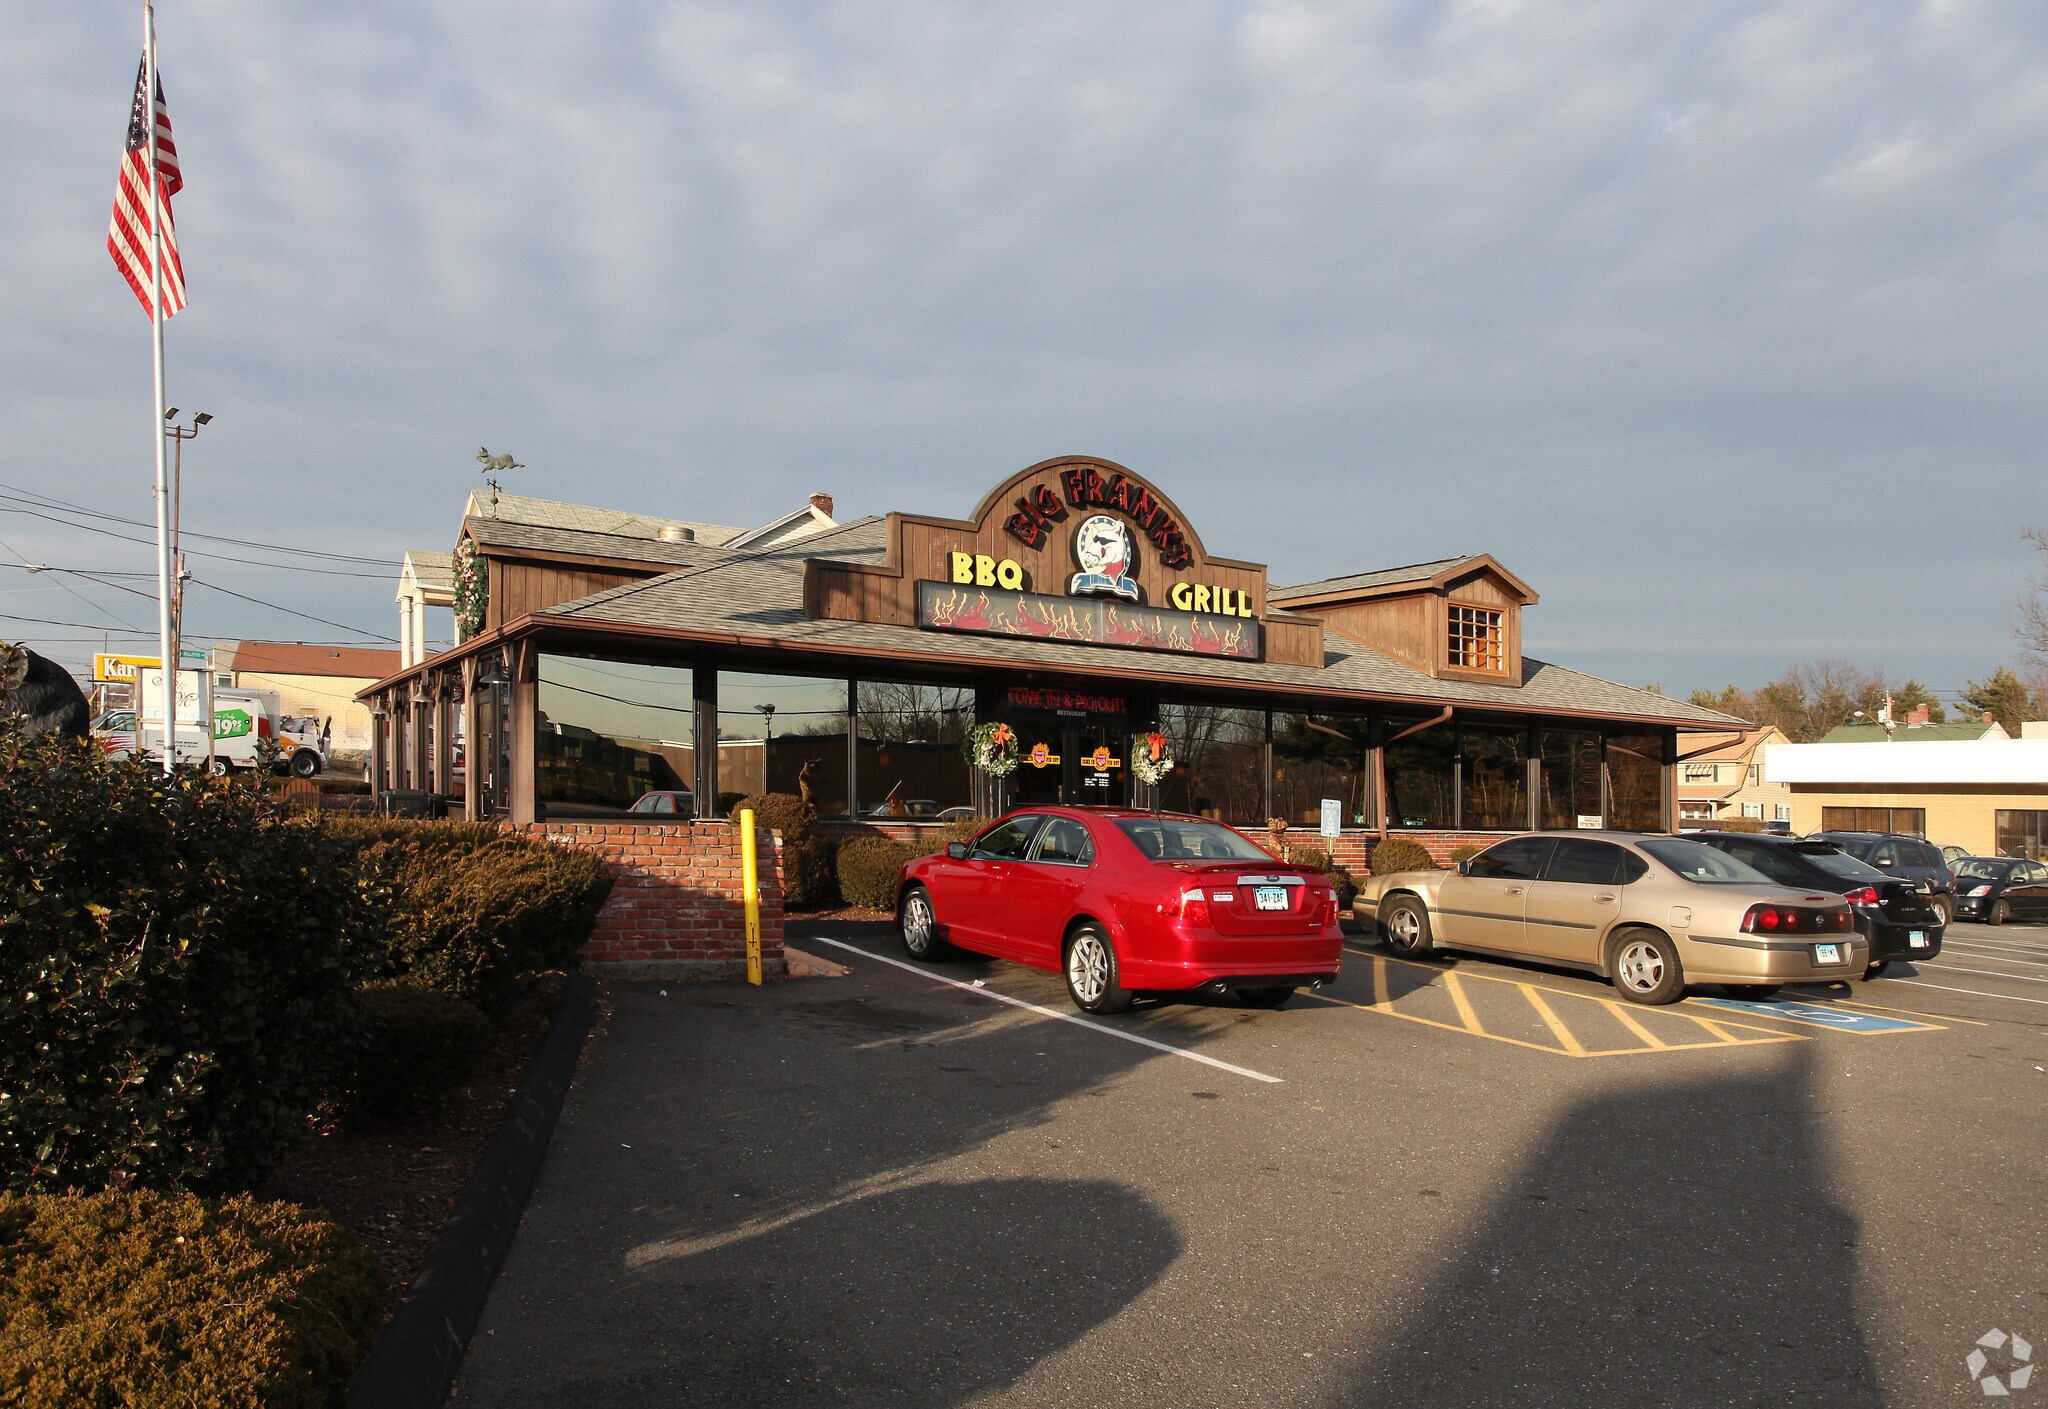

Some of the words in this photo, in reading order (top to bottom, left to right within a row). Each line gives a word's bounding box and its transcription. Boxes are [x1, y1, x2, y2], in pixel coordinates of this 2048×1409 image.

[1003, 484, 1061, 545] BIG
[951, 551, 1024, 591] BBQ
[1171, 582, 1252, 618] GRILL
[1007, 688, 1043, 705] COME
[1046, 690, 1060, 707] IN
[1064, 693, 1072, 707] &
[1075, 694, 1095, 710] PIG
[1057, 709, 1087, 717] RESTAURANT
